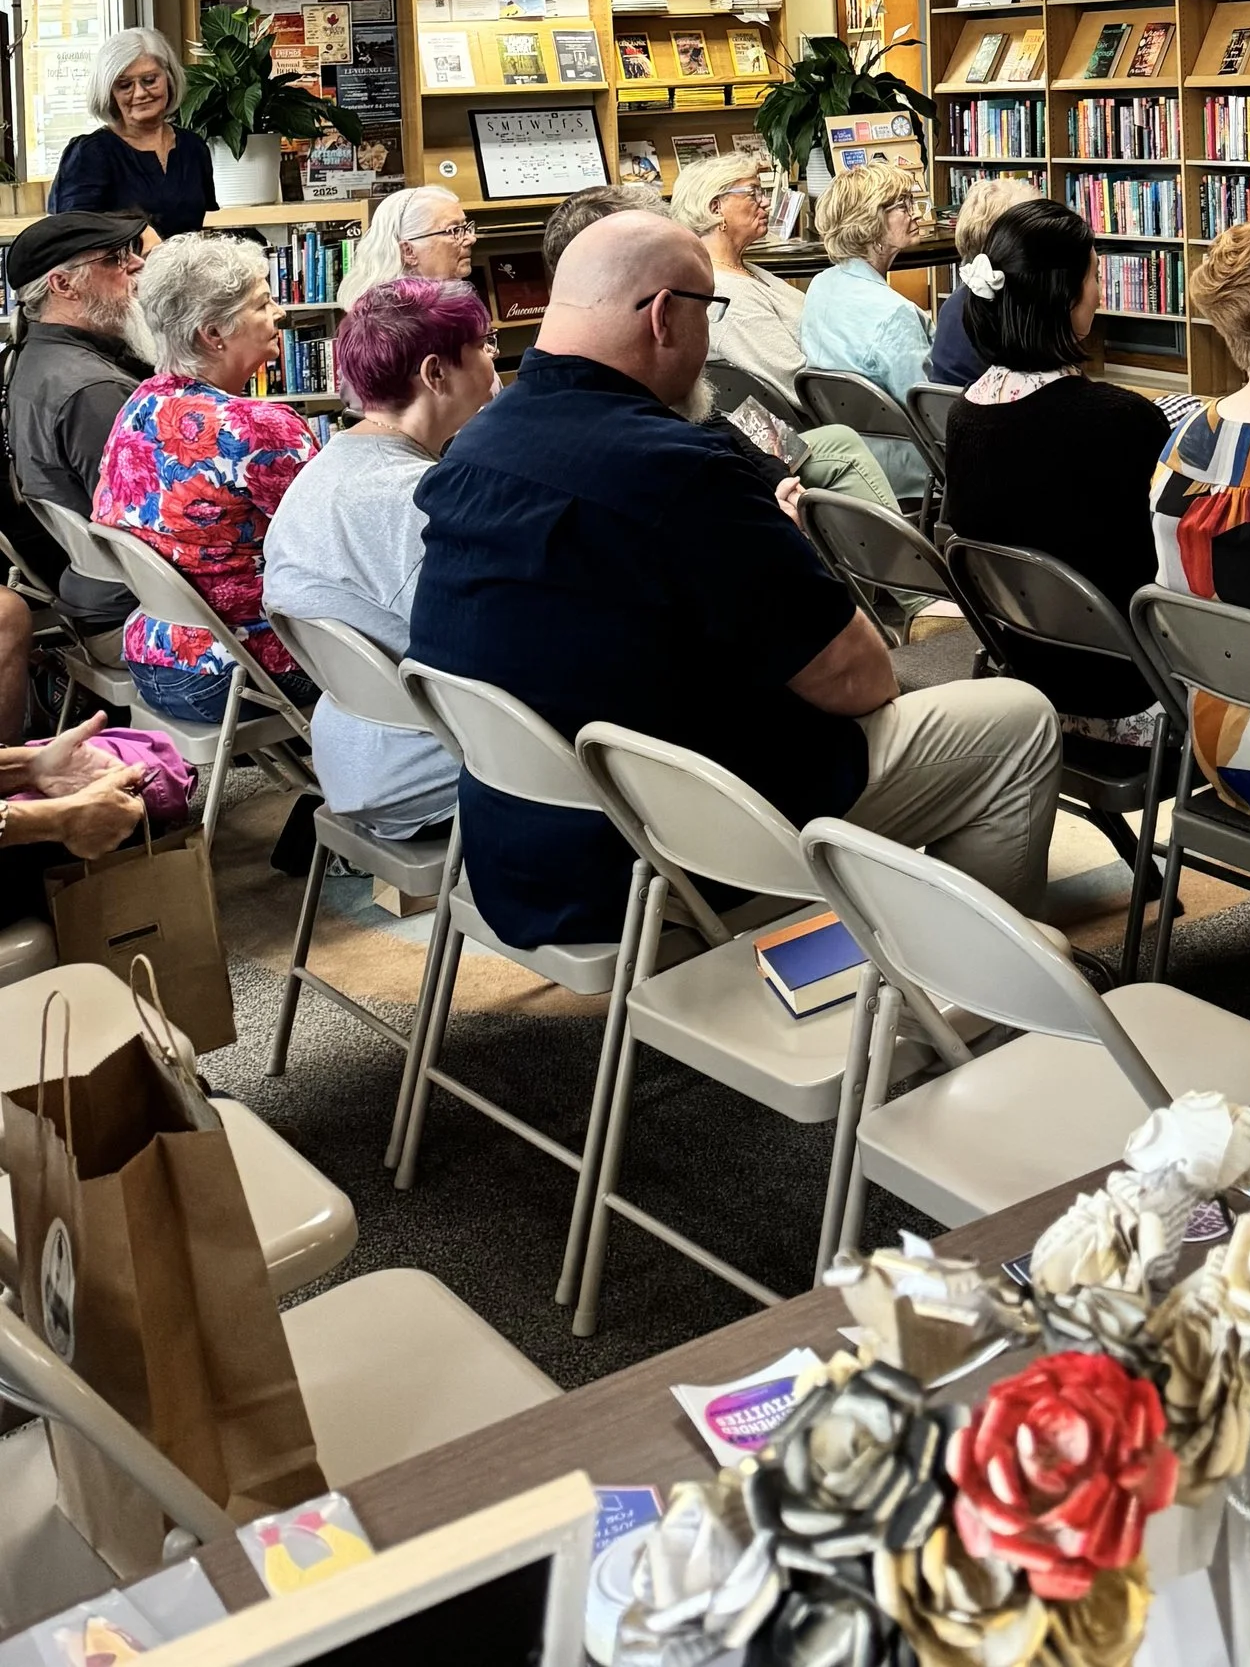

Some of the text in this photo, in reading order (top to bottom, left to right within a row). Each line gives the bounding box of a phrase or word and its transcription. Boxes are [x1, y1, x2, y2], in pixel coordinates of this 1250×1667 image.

[487, 121, 494, 132] S
[501, 120, 510, 131] M
[529, 119, 540, 130] W
[576, 117, 583, 128] S
[312, 186, 338, 197] 2025
